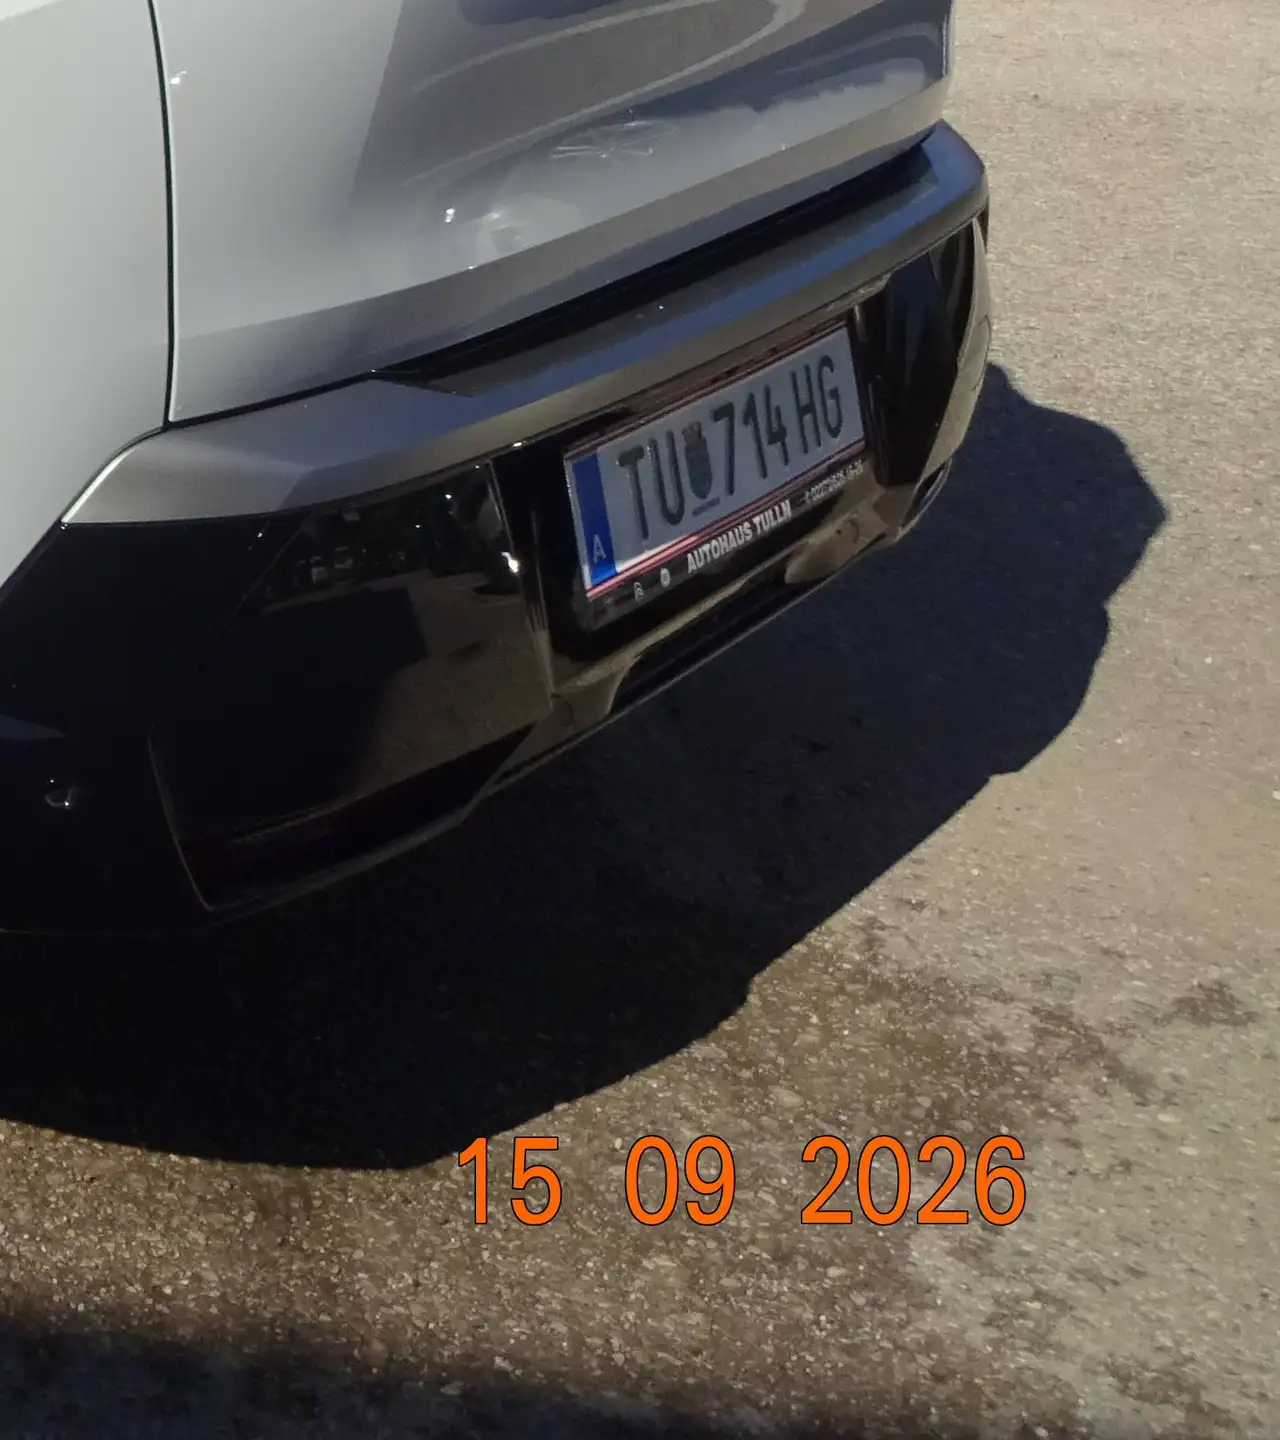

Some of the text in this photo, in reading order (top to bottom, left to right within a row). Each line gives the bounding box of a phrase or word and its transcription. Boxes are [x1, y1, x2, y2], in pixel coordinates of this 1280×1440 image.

[615, 428, 686, 540] TU
[710, 382, 790, 496] 714
[790, 354, 844, 455] HG
[591, 532, 607, 563] A
[686, 499, 793, 574] AUTOHAUS TULLN
